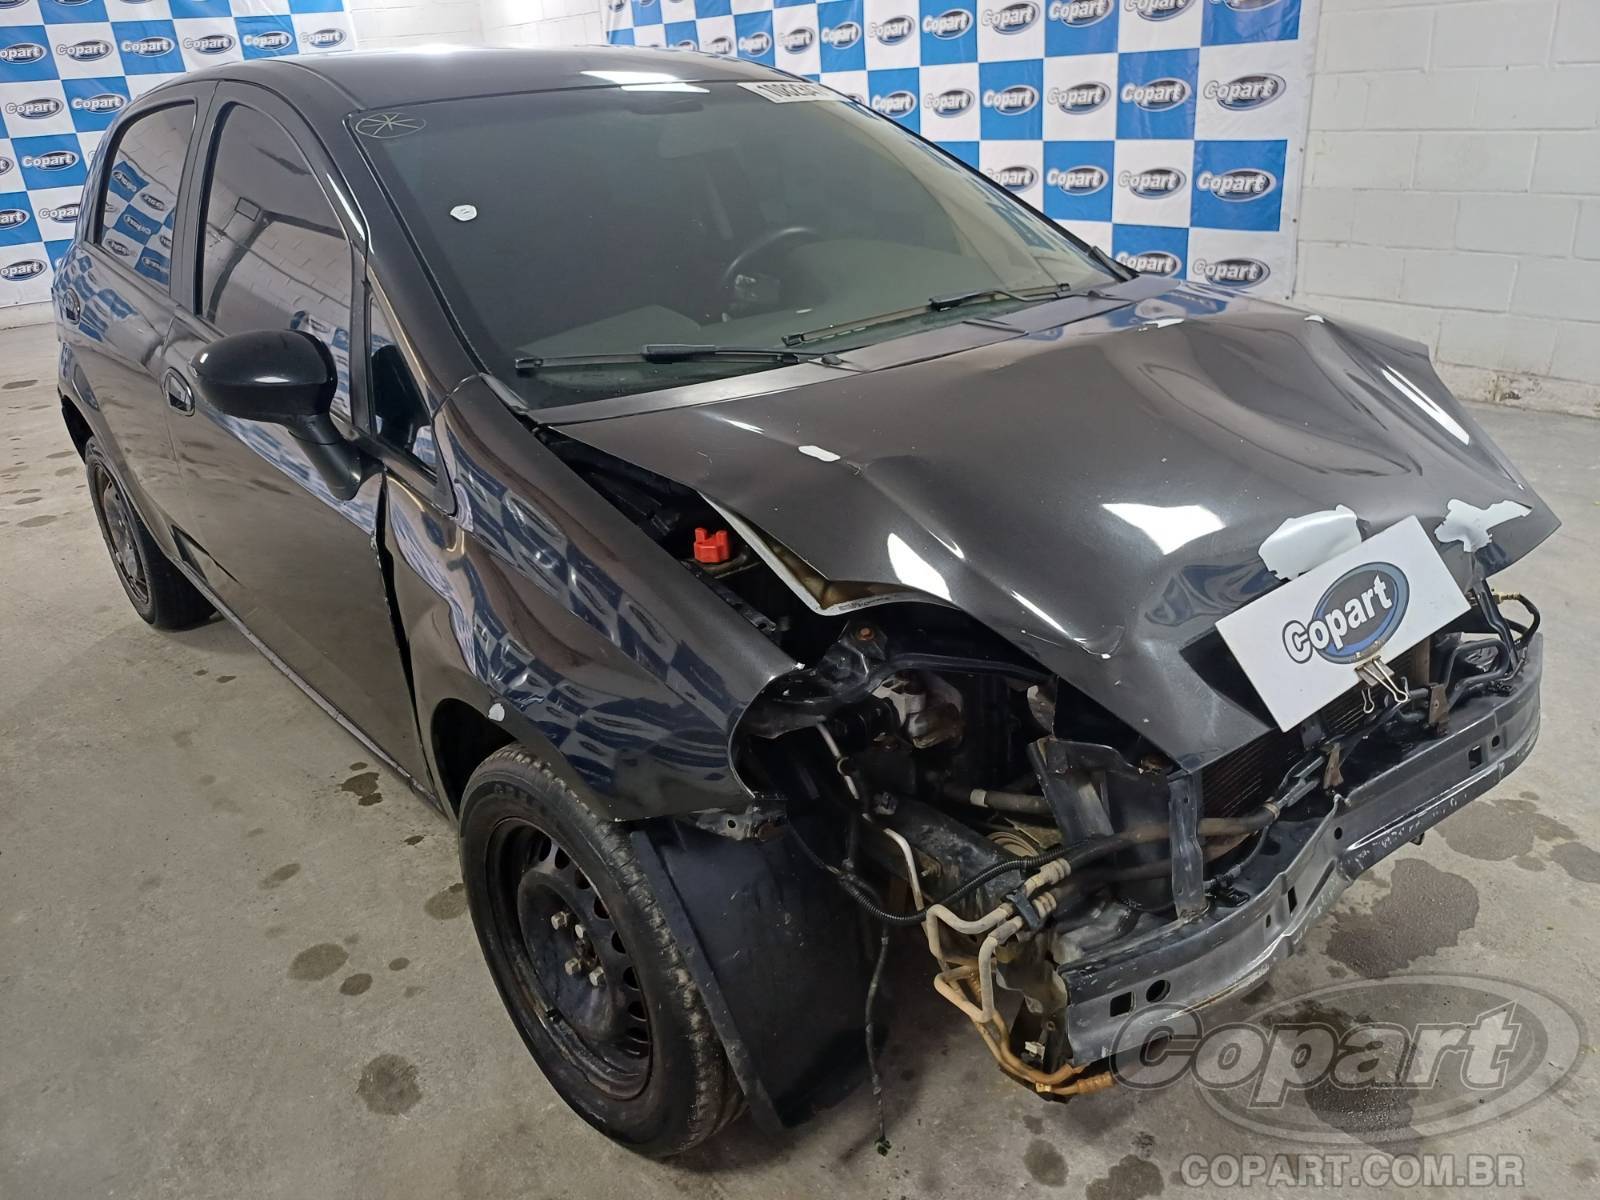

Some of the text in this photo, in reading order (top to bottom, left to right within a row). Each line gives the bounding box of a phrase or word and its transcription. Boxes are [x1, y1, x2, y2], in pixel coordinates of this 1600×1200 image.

[982, 4, 1032, 30] Copart
[1049, 0, 1103, 23] Copart
[870, 20, 909, 41] Copart
[923, 13, 967, 35] Copart
[184, 36, 229, 50] Copart
[243, 34, 287, 47] Copart
[301, 32, 340, 45] Copart
[822, 26, 857, 45] Copart
[0, 47, 40, 60] opart
[57, 42, 106, 58] Copart
[122, 40, 169, 53] Copart
[983, 88, 1032, 110] Copart
[1048, 86, 1102, 107] Copart
[1121, 82, 1181, 106] Copart
[1204, 78, 1274, 104] Copart
[6, 100, 57, 115] Copart
[73, 95, 121, 111] Copart
[872, 95, 910, 113] Copart
[924, 92, 968, 113] Copart
[22, 153, 73, 169] Copart
[1047, 168, 1100, 190] Copart
[1118, 170, 1176, 193] Copart
[1196, 171, 1265, 196] Copart
[39, 208, 79, 222] Copa
[0, 262, 39, 277] opart
[1116, 252, 1172, 273] Copart
[1193, 258, 1259, 280] Copart
[1283, 574, 1393, 664] Copart
